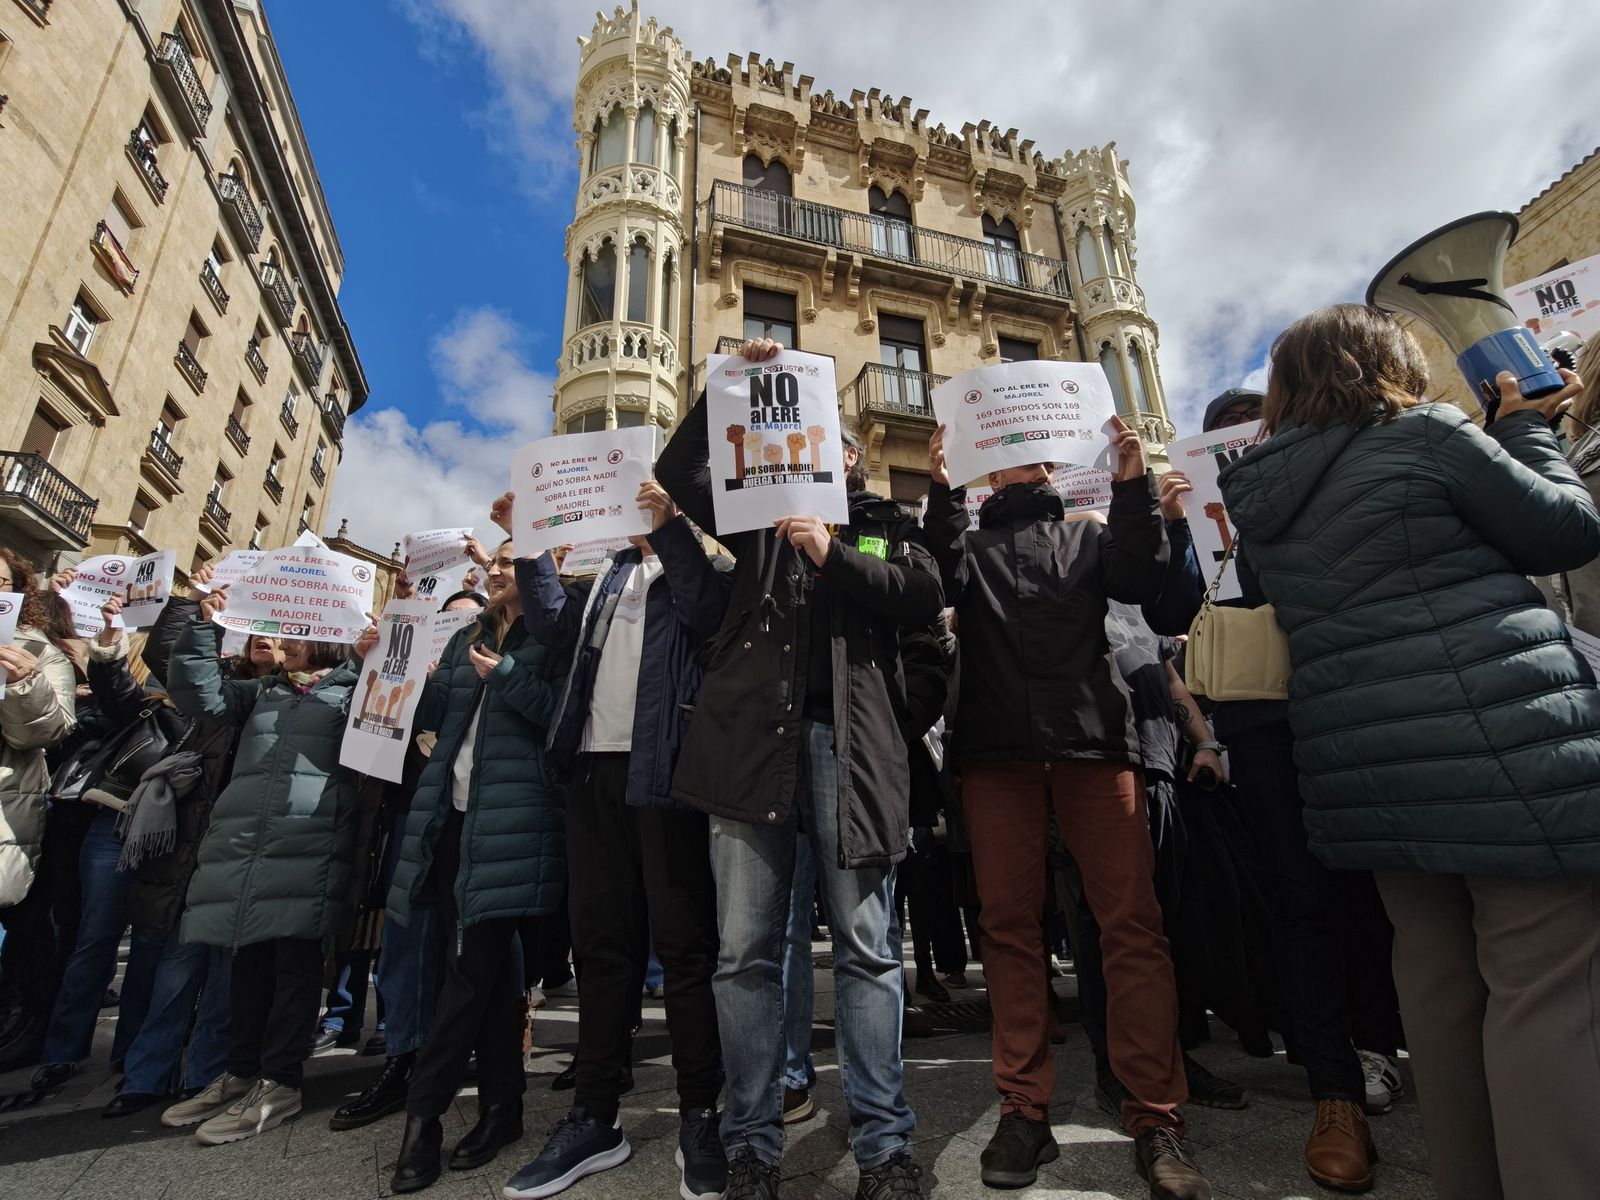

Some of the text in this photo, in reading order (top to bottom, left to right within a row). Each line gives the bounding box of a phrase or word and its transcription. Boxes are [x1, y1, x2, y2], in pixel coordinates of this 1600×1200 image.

[1536, 280, 1576, 308] NO
[1541, 296, 1580, 315] al ERE
[764, 365, 782, 373] CGT
[784, 365, 798, 373] UGT
[750, 372, 799, 408] NO
[1004, 392, 1044, 400] MAJOREL
[751, 407, 801, 424] al ERE
[976, 411, 992, 420] 169
[995, 404, 1040, 415] DESPIDOS
[765, 422, 802, 432] Majorel
[981, 415, 1024, 431] FAMILIAS
[1026, 431, 1048, 440] CGT
[1227, 439, 1247, 448] CGT
[557, 466, 590, 475] MAJOREL
[758, 464, 786, 474] SOBRA
[553, 479, 564, 488] NO
[566, 475, 591, 485] SOBRA
[594, 471, 618, 481] NADIE
[743, 474, 814, 488] HUELGA 10 MARZO
[545, 492, 567, 503] SOBRA
[579, 487, 593, 495] ERE
[1068, 488, 1100, 496] FAMILIAS
[557, 500, 591, 512] MAJOREL
[1077, 497, 1094, 506] CGT
[564, 512, 582, 522] CGT
[585, 509, 599, 518] UGT
[305, 557, 324, 565] ERE
[432, 561, 443, 570] CGT
[137, 562, 155, 576] NO
[280, 566, 327, 576] MAJOREL
[241, 575, 364, 597] AQUÍ NO SOBRA NADIE
[419, 577, 437, 589] NO
[74, 600, 88, 608] 169
[252, 592, 347, 609] SOBRA EL ERE DE
[271, 609, 323, 621] MAJOREL
[282, 623, 309, 635] CGT
[313, 626, 332, 635] UGT
[387, 624, 414, 660] NO
[382, 659, 409, 676] al ERE
